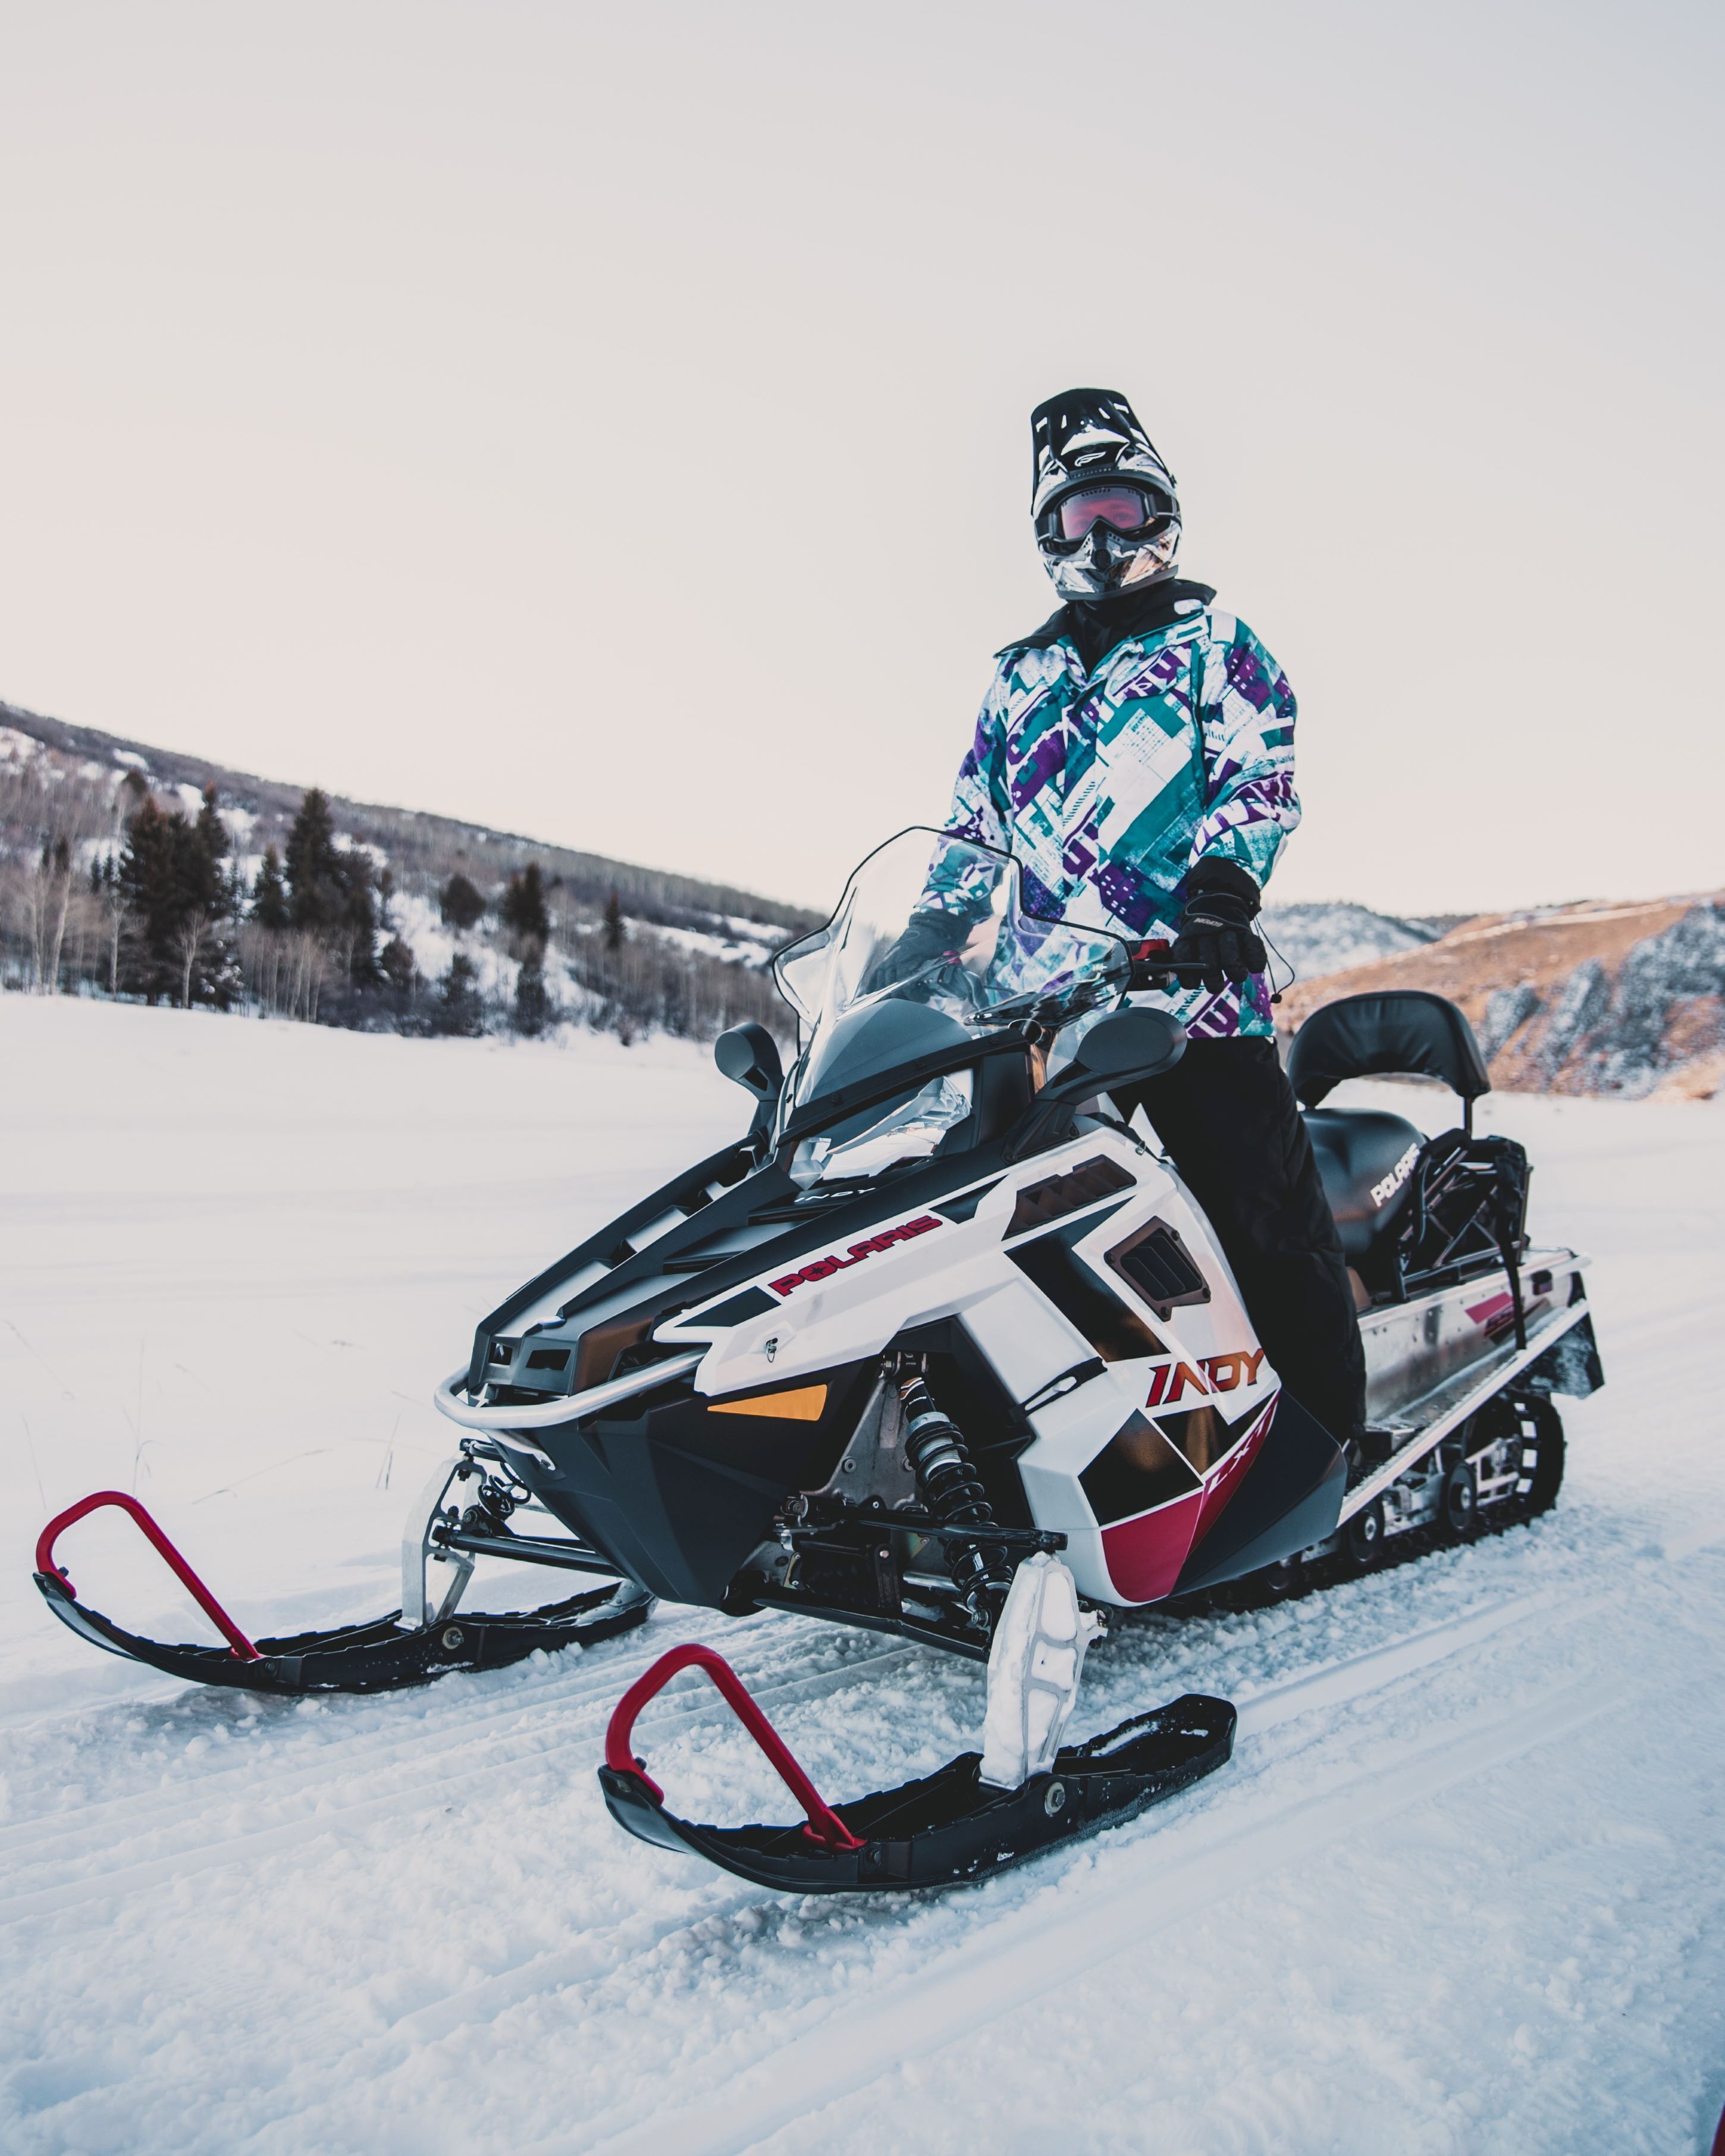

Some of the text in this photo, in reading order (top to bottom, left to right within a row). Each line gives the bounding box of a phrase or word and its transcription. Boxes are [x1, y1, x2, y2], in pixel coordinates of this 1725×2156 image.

[794, 1187, 876, 1203] INDY
[767, 1215, 943, 1297] POLARIS
[1145, 1348, 1265, 1408] INDY
[1208, 1408, 1271, 1495] LXT
